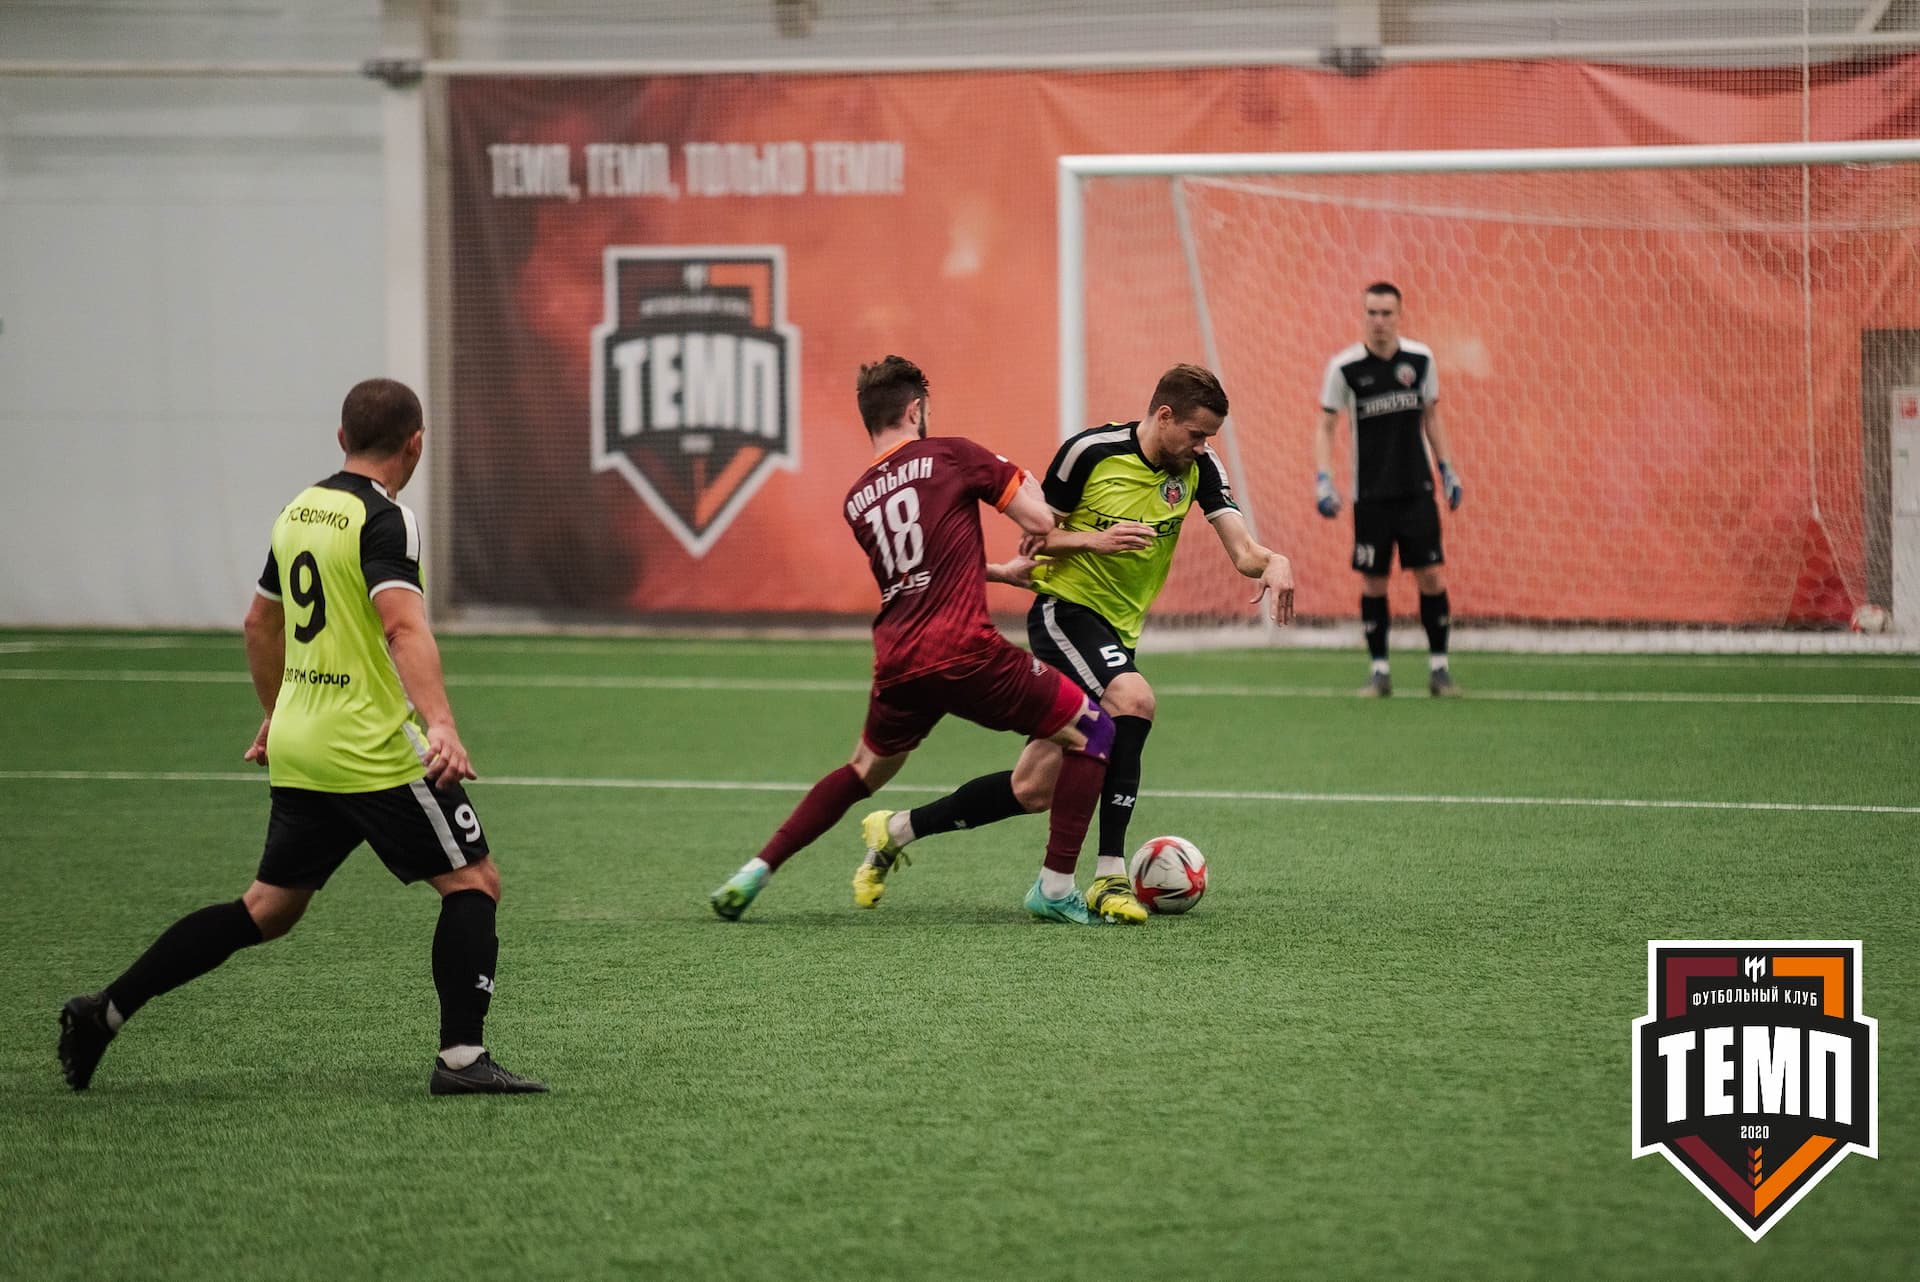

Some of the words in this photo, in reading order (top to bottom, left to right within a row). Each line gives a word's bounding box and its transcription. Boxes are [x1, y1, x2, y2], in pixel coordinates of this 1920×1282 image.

[613, 332, 780, 438] ТЕМП
[864, 487, 924, 579] 18
[289, 551, 326, 644] 9
[309, 669, 351, 689] Group
[1099, 644, 1128, 668] 5
[454, 803, 481, 843] 9
